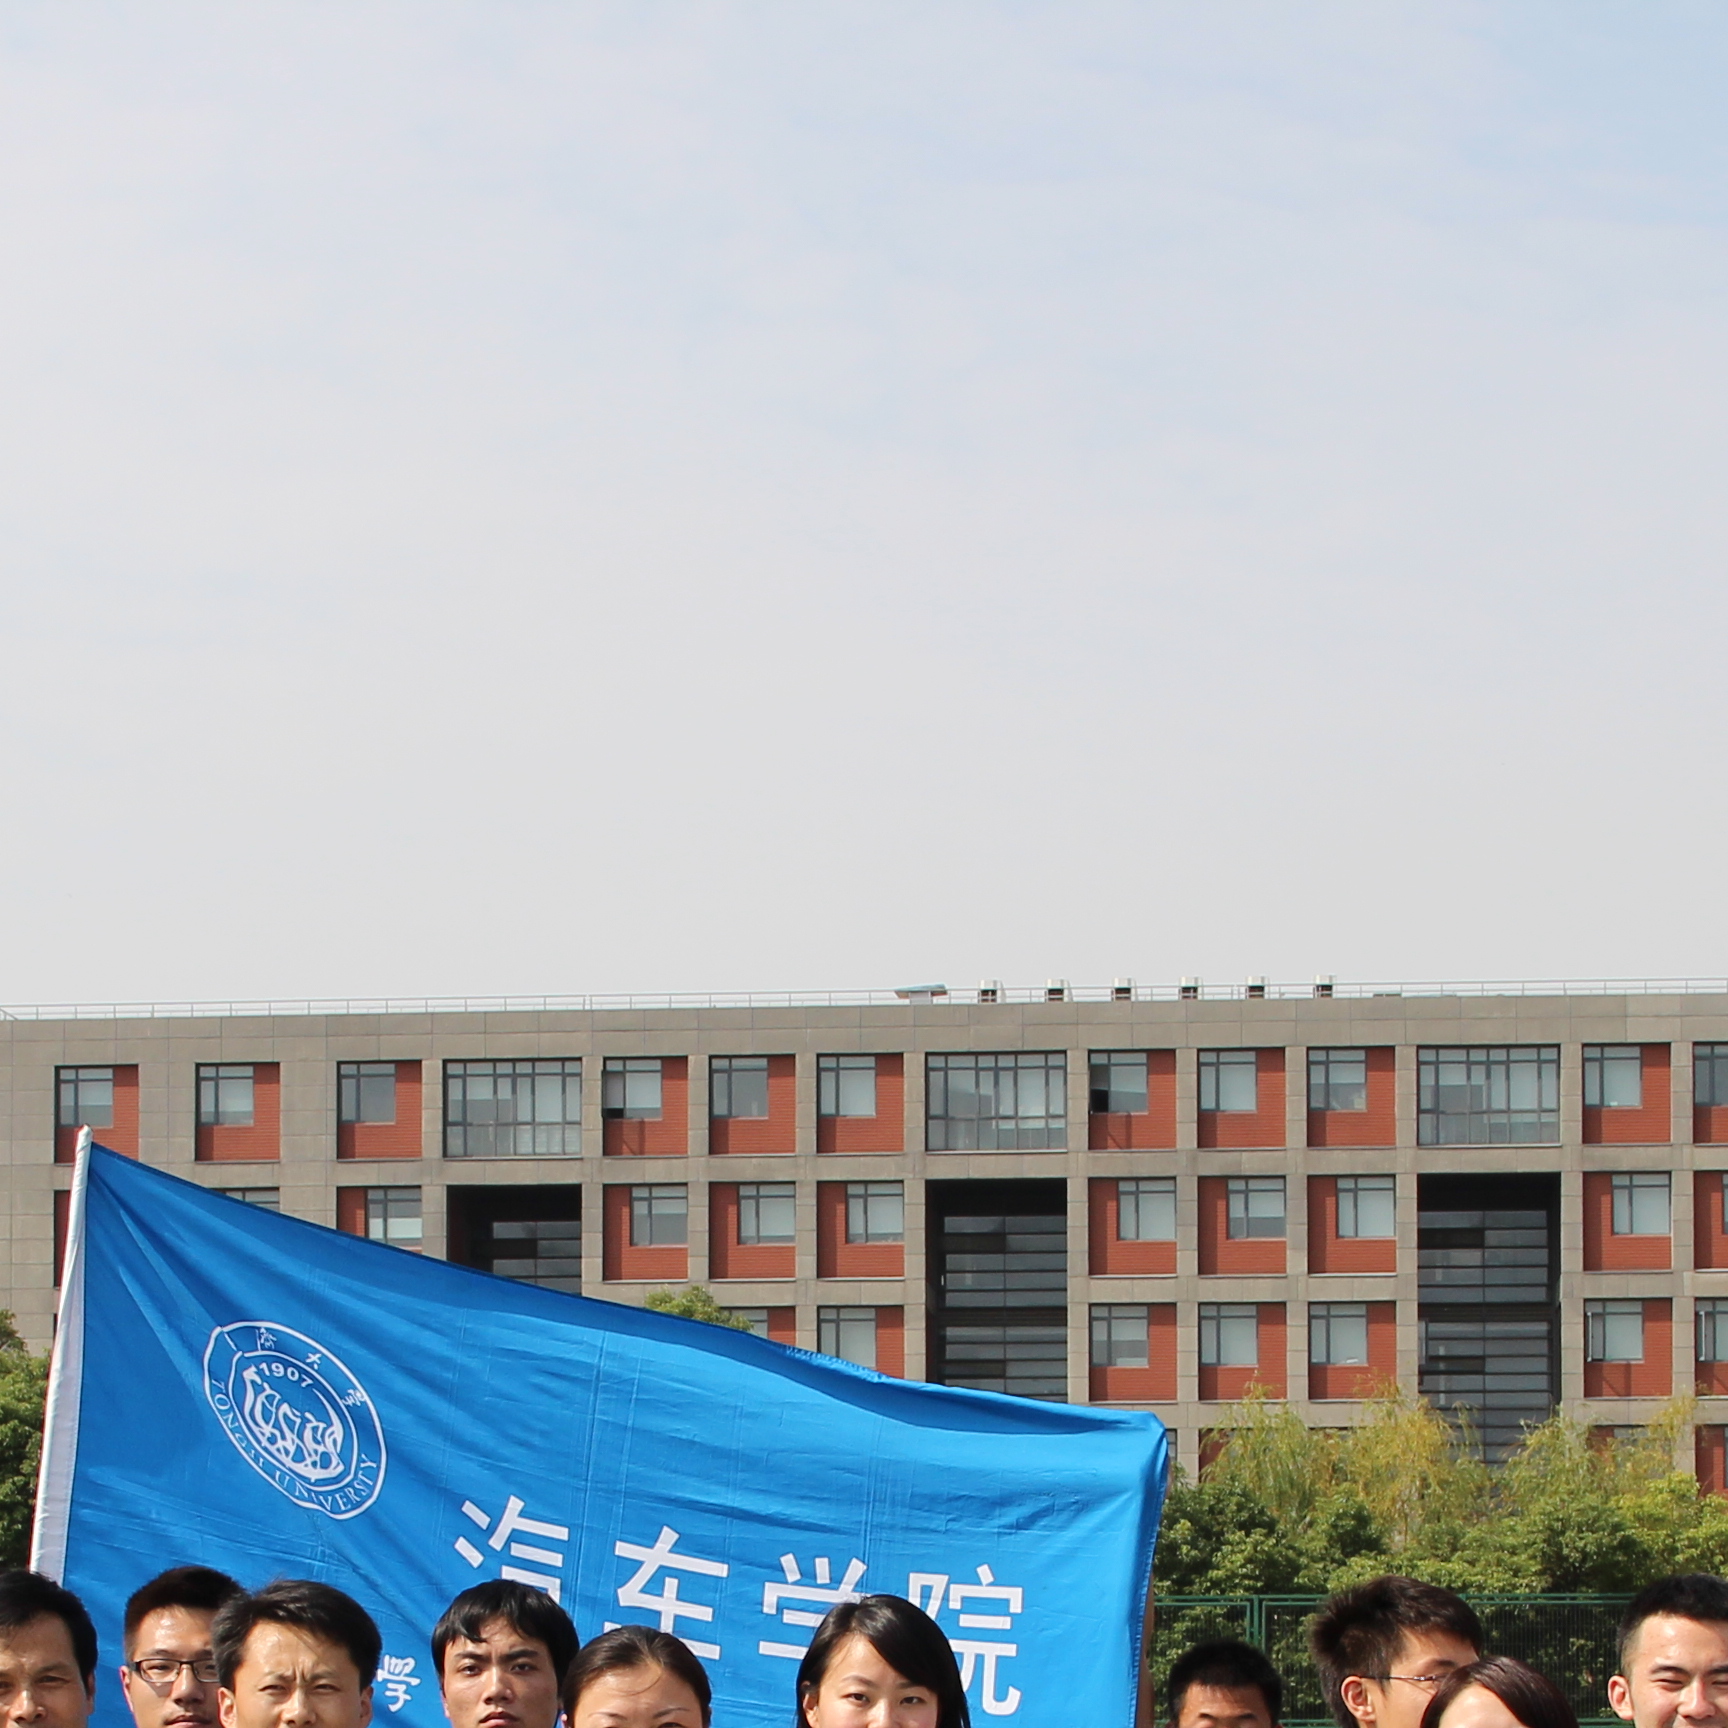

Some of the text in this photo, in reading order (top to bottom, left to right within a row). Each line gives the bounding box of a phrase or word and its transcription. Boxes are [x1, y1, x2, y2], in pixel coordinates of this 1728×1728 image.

[258, 1361, 314, 1388] 1907
[274, 1452, 378, 1512] UNIVERSITY
[453, 1494, 1023, 1716] 汽车学院
